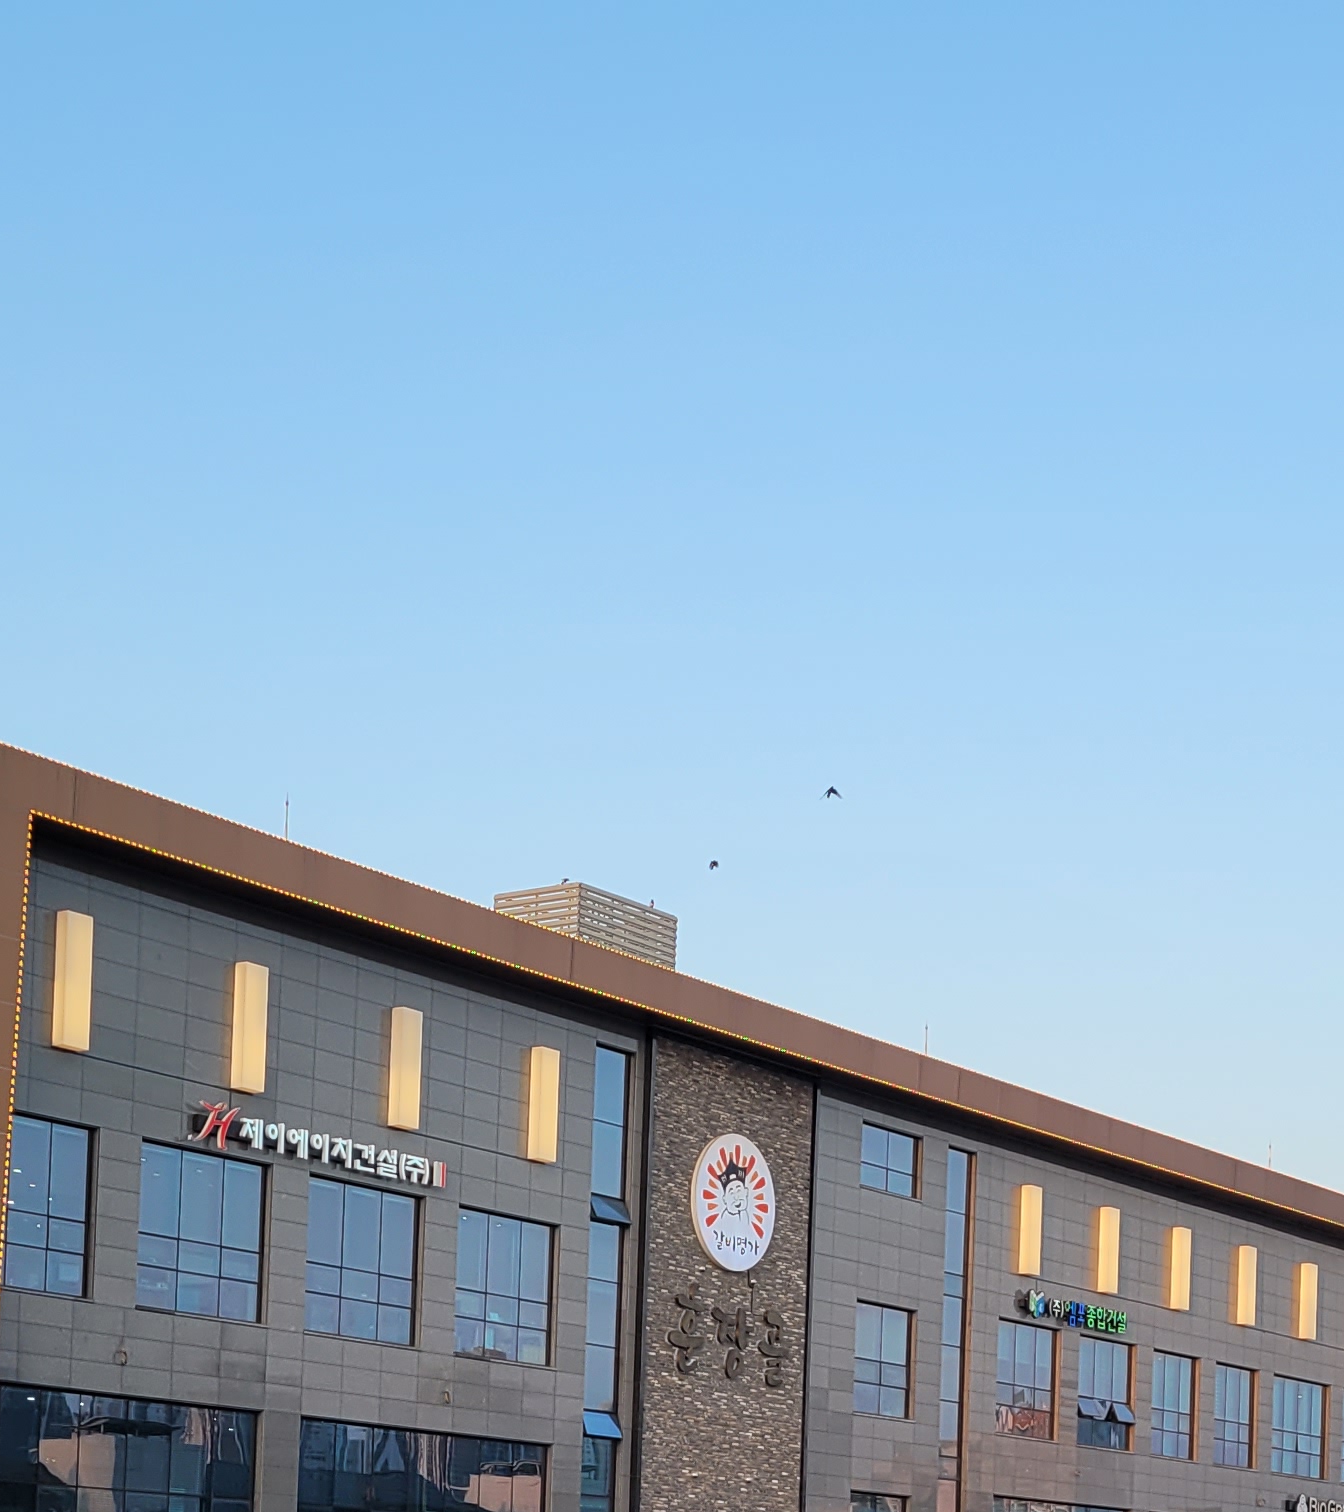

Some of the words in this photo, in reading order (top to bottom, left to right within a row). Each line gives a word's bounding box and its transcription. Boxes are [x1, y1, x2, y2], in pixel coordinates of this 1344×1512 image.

[239, 1116, 431, 1186] 제이에이치건설(주)
[713, 1230, 760, 1256] 갈비명가
[665, 1281, 789, 1388] 훈장골
